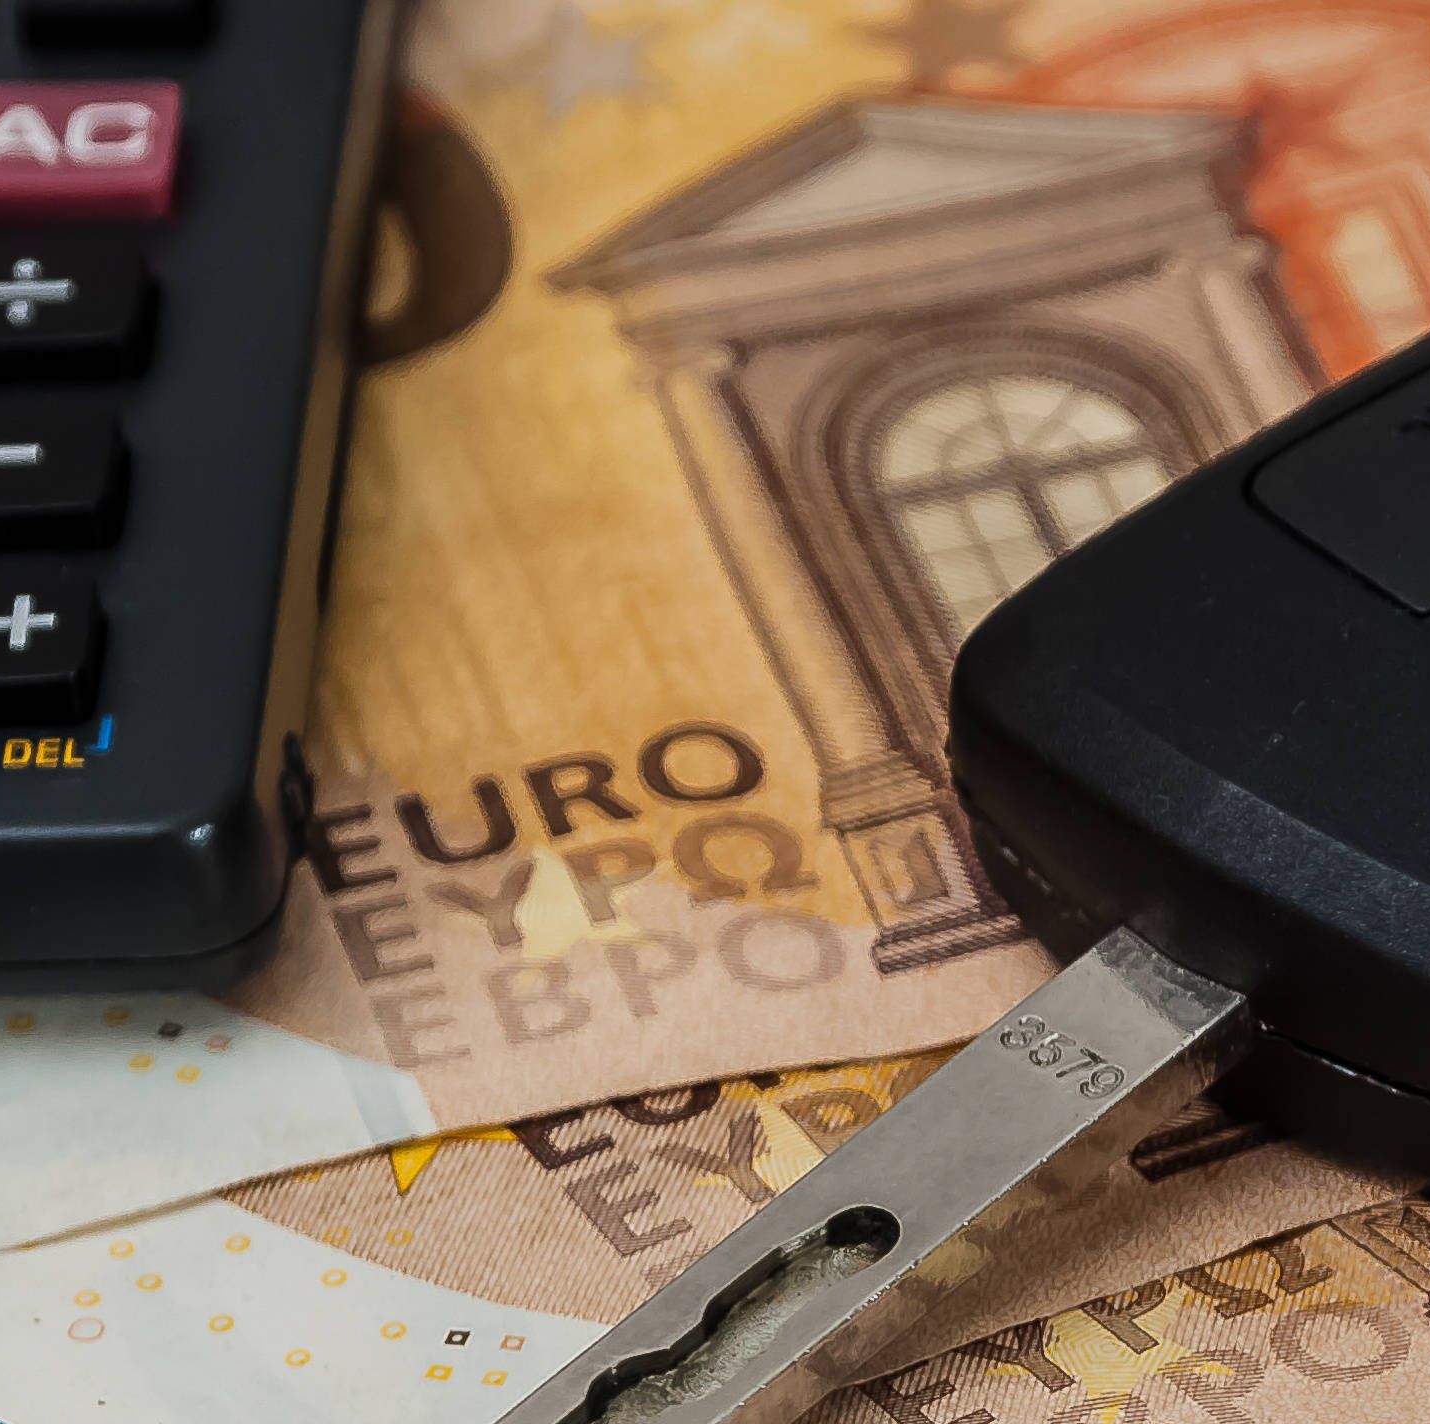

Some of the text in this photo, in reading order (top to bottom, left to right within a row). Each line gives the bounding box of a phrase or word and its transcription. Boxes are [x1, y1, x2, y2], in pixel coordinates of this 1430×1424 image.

[3, 737, 86, 770] DEL
[307, 720, 767, 896] EURO
[563, 1084, 916, 1260] ΕΥΡ
